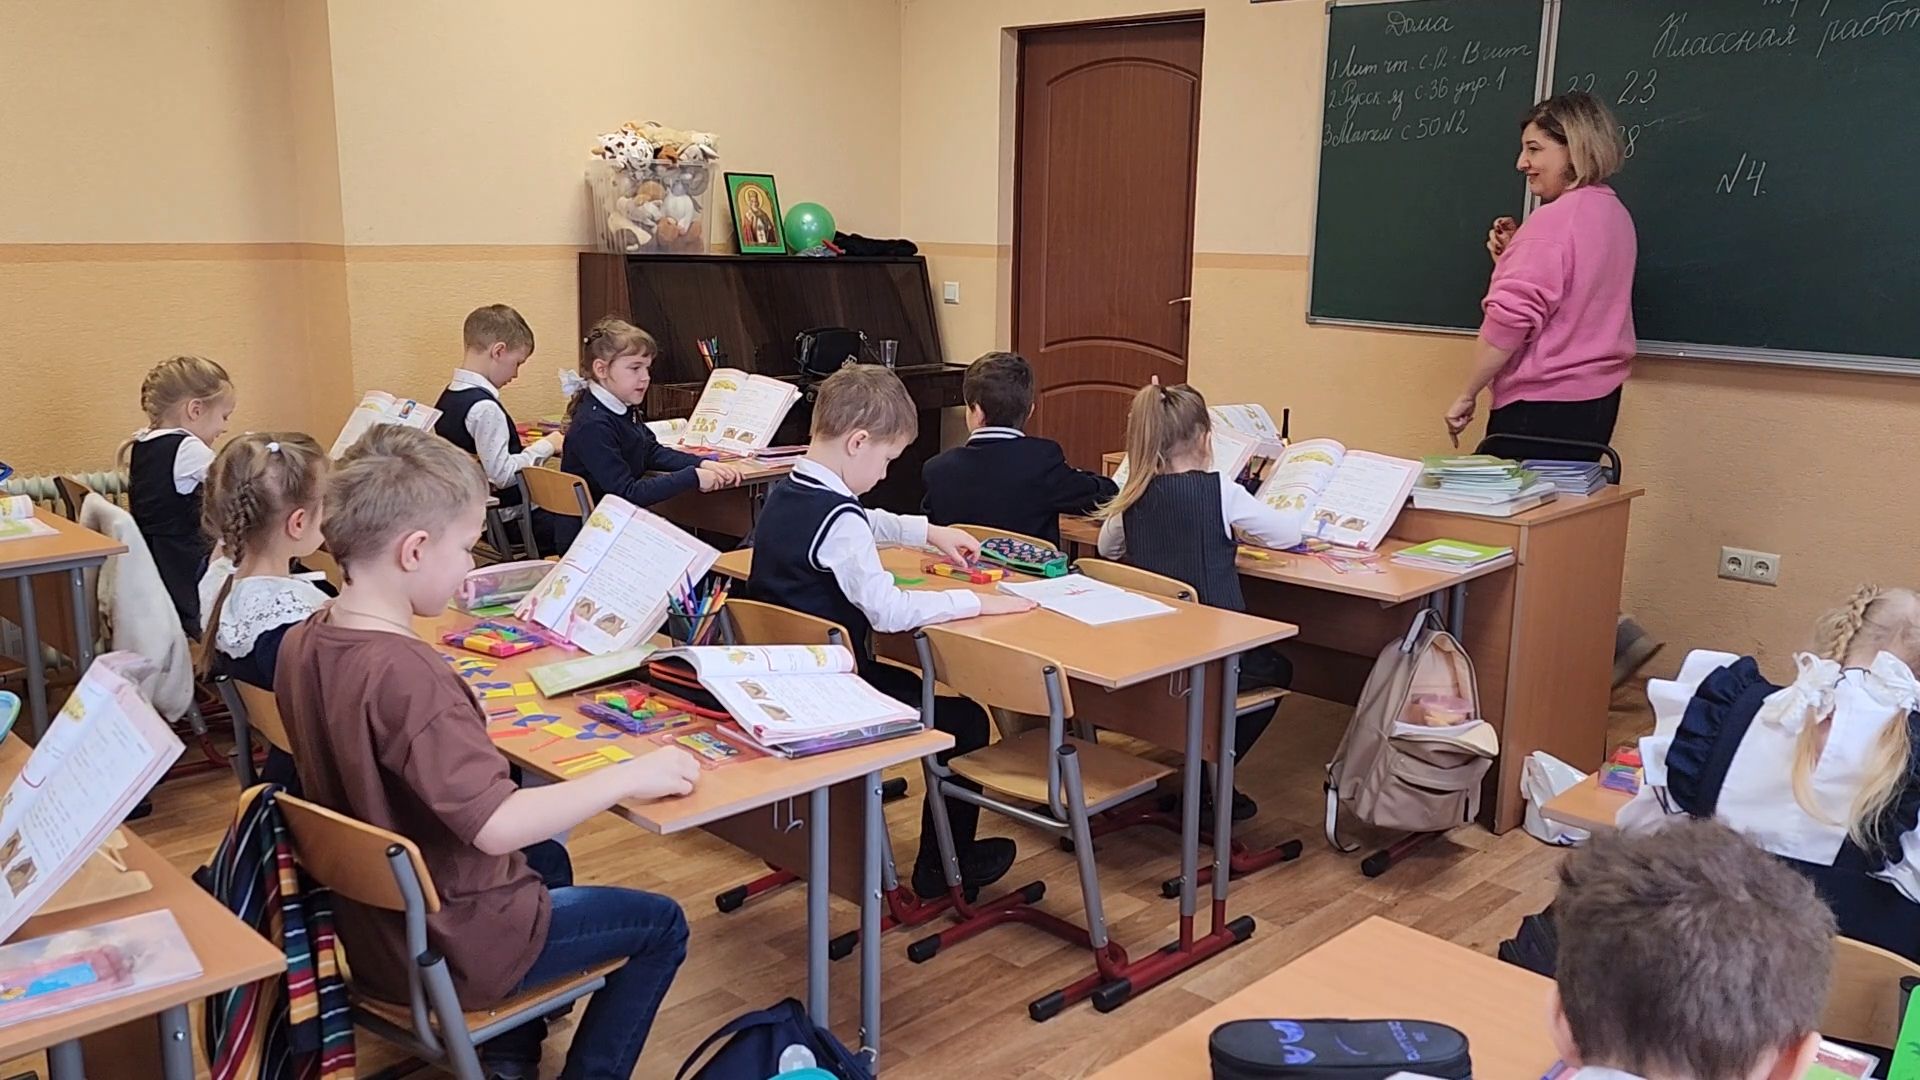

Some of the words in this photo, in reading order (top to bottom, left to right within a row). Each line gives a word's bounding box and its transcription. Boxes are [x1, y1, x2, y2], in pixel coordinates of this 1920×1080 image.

[1385, 10, 1455, 37] Дома
[1652, 12, 1799, 58] Классная
[1616, 68, 1658, 105] 23
